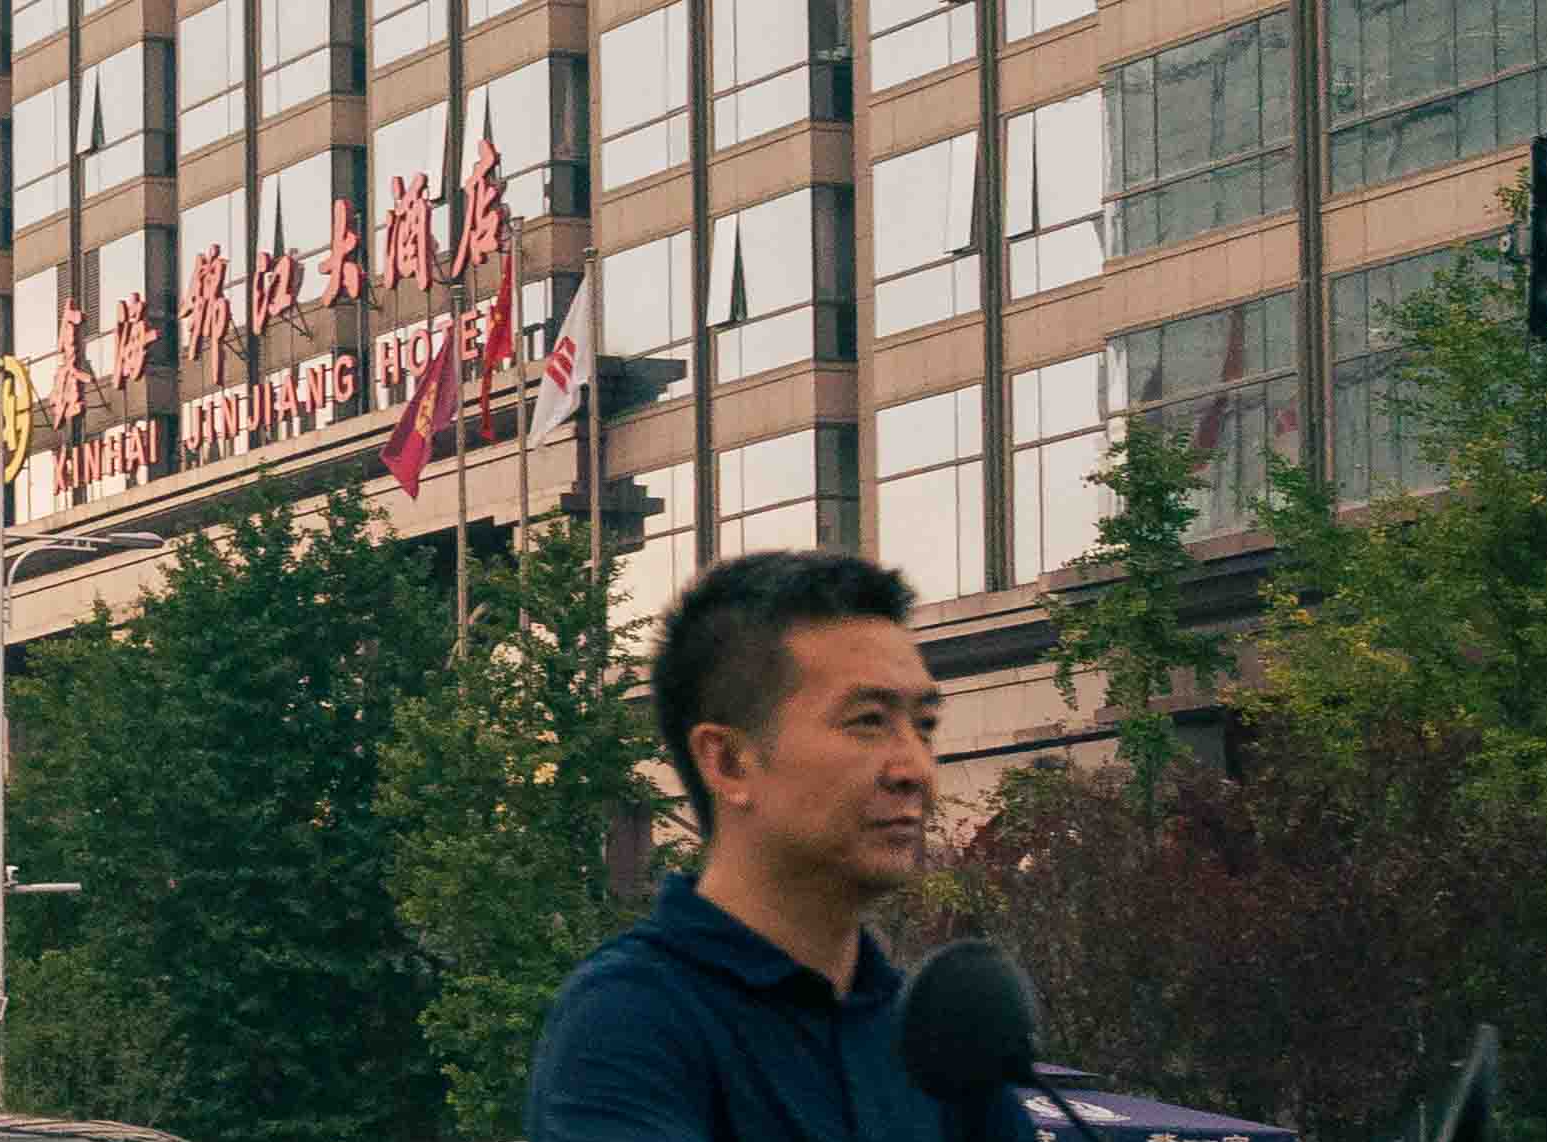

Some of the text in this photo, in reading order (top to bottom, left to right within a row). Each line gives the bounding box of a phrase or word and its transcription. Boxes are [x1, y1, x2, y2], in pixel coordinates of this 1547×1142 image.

[53, 420, 158, 497] XINHAI
[186, 353, 357, 450] JINJIANG
[376, 304, 496, 386] HOTE
